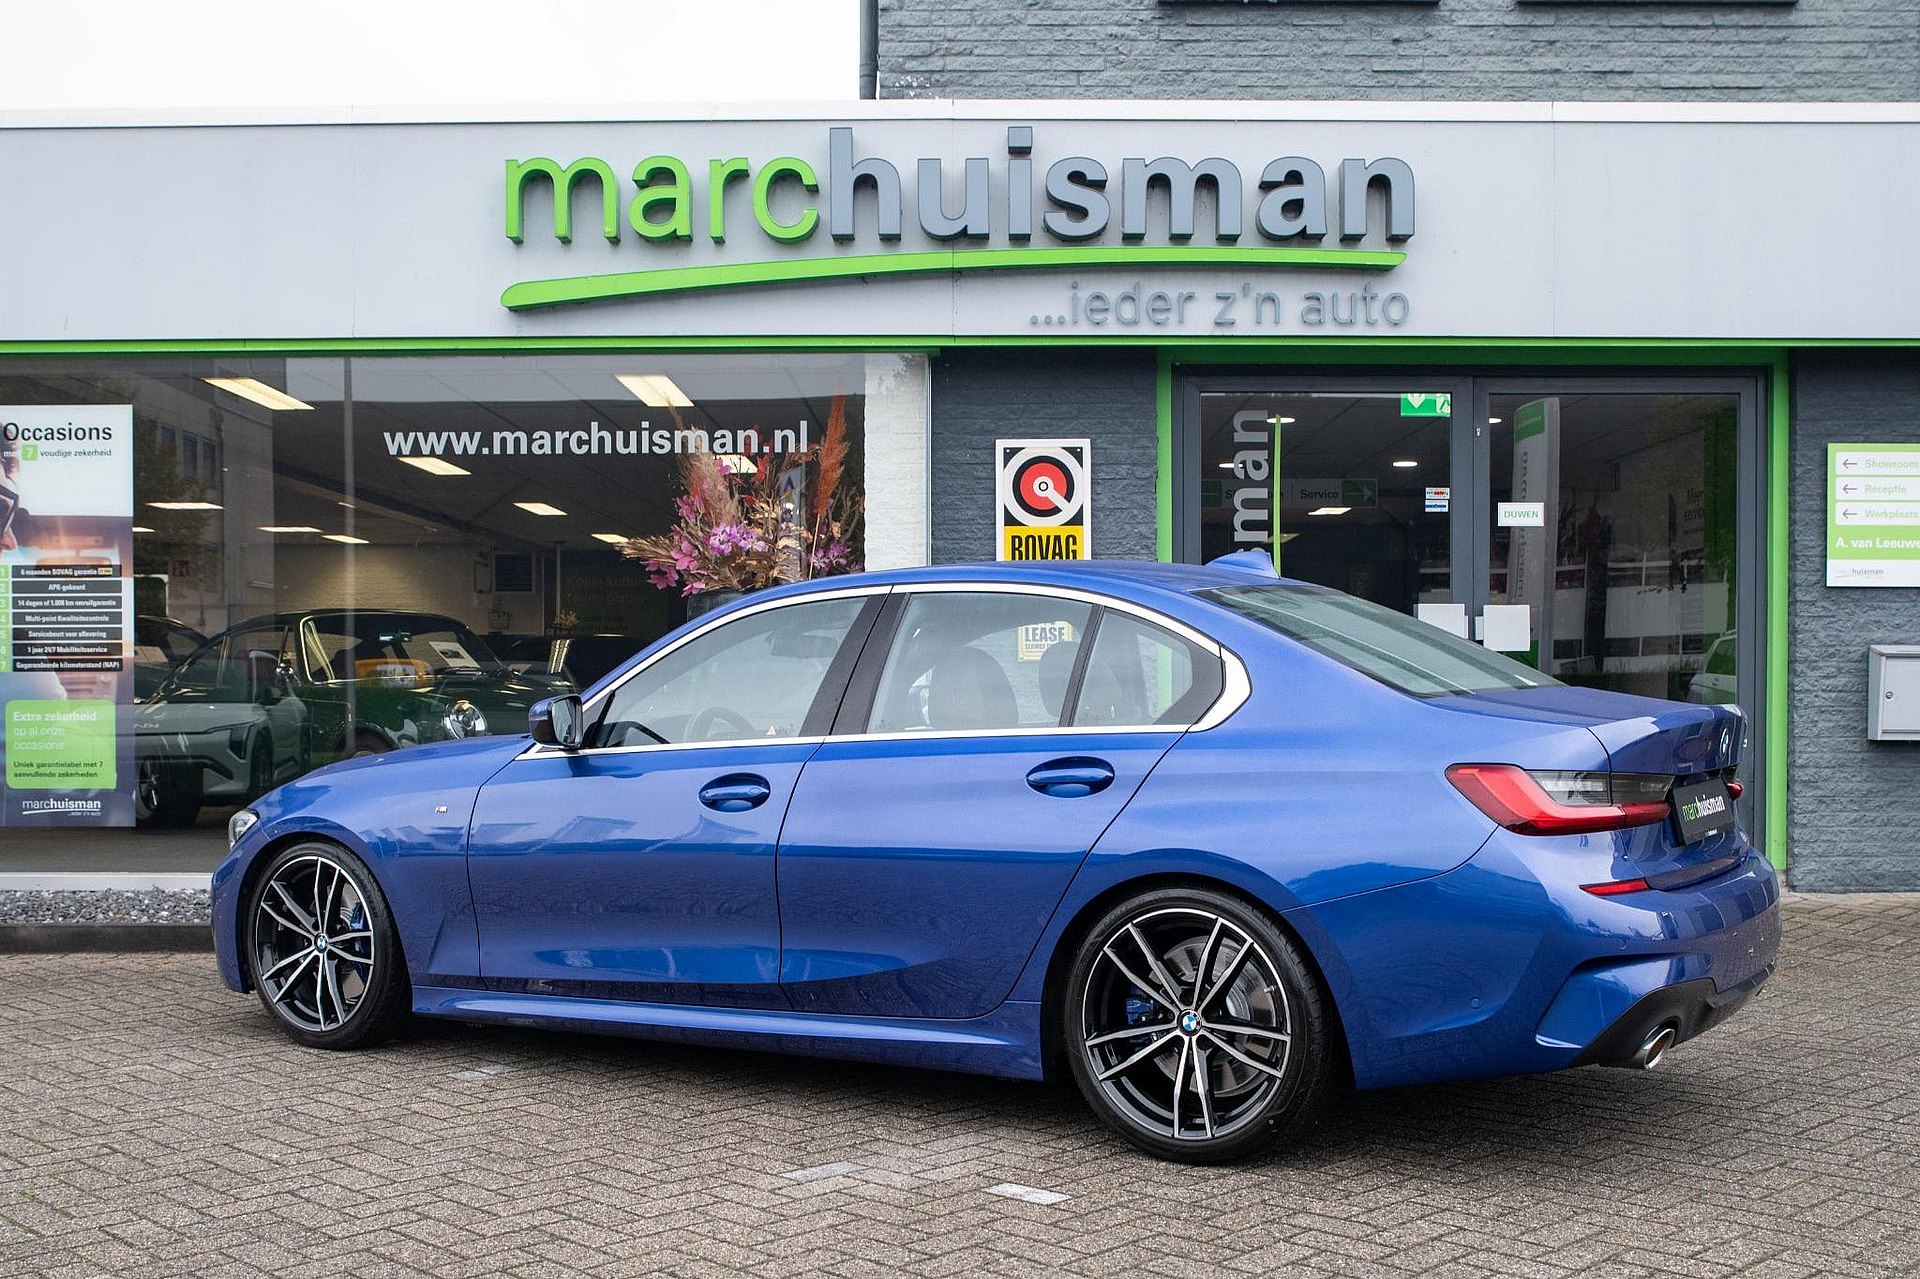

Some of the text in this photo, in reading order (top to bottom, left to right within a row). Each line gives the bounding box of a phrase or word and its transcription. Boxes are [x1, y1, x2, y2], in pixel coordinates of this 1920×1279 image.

[504, 126, 1416, 245] marchuisman
[1214, 281, 1281, 325] z'n
[1301, 281, 1410, 326] auto
[3, 422, 113, 441] Occasions
[383, 421, 808, 455] www.marchuisman.nl
[40, 449, 72, 457] voudige
[73, 449, 112, 457] zekerheid
[1864, 459, 1919, 468] Showroom
[1300, 489, 1340, 499] Service
[1865, 484, 1907, 495] Receptie
[1503, 510, 1539, 519] DUWEN
[1864, 509, 1919, 520] Werkplaats
[1011, 534, 1078, 561] BOVAG
[1835, 537, 1848, 548] A.
[1851, 540, 1873, 548] van
[1024, 626, 1065, 642] LEASE
[13, 712, 42, 721] Extra
[22, 798, 101, 809] marchuisman
[1682, 794, 1726, 822] marchuisman
